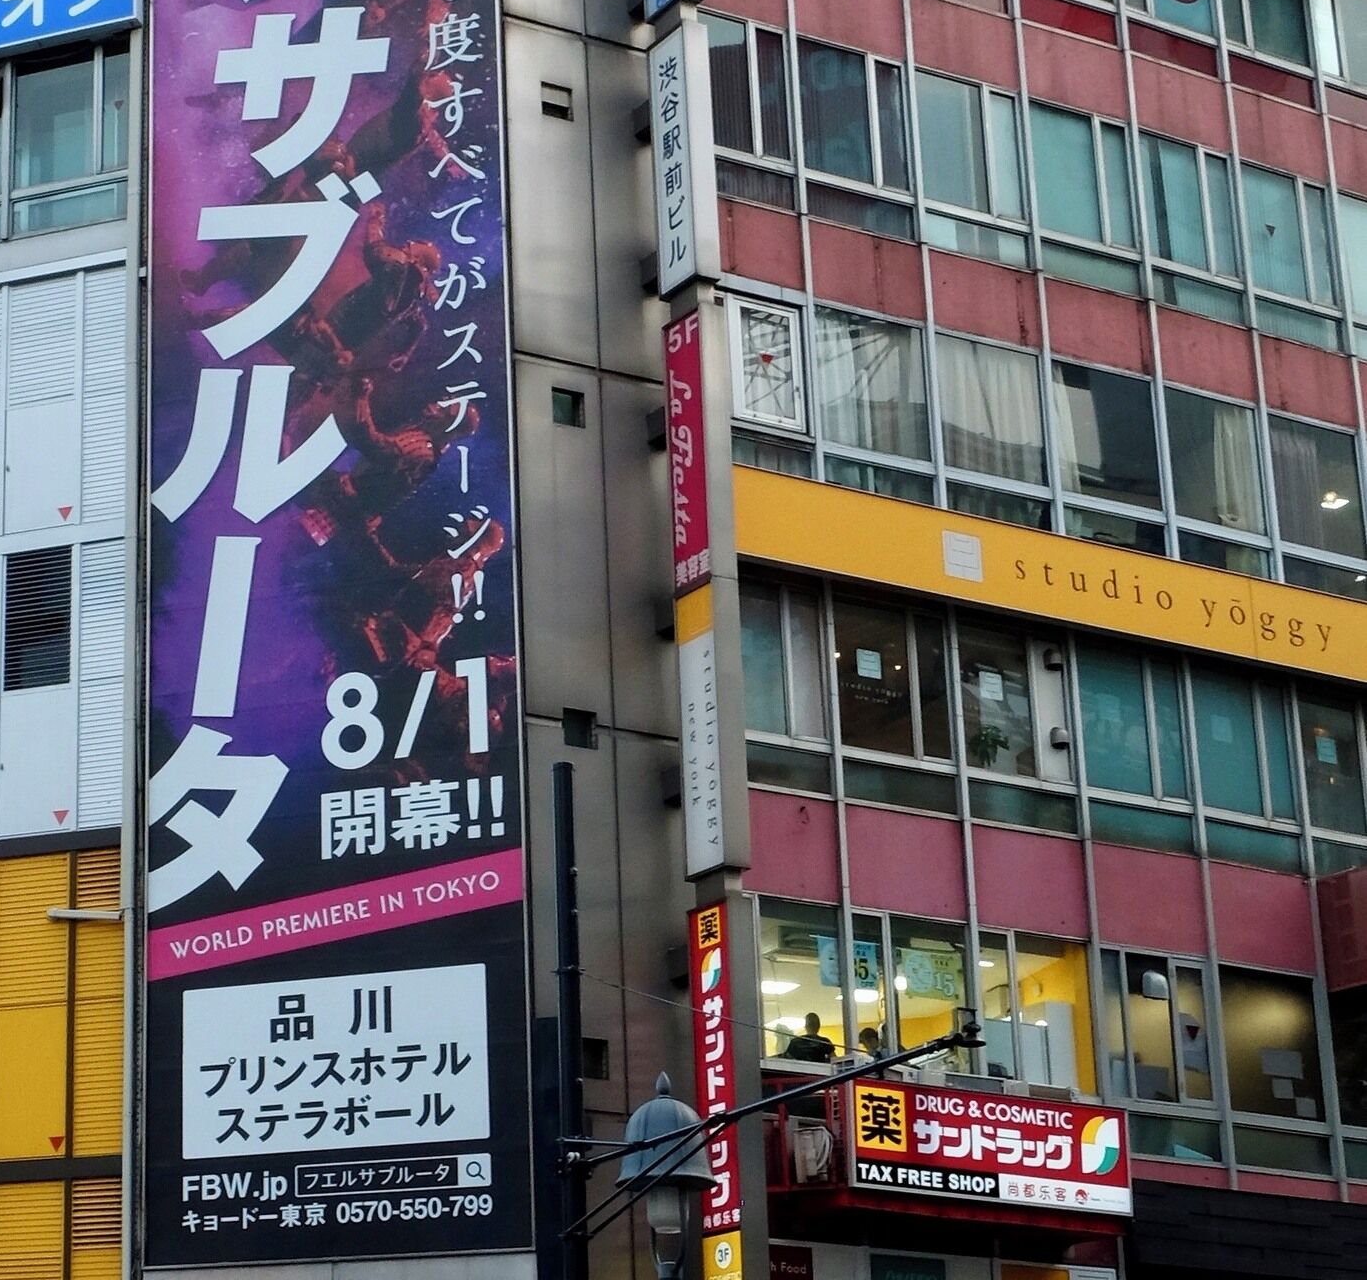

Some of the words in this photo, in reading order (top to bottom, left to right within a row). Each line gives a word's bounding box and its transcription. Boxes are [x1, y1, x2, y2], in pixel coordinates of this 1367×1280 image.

[658, 56, 687, 269] 渋谷駅前ビル
[667, 315, 700, 354] 5F
[675, 547, 711, 588] 美容室
[1014, 556, 1174, 612] studio
[320, 656, 493, 771] 8/1
[320, 774, 507, 861] 開幕!!
[170, 926, 254, 960] WORLD
[262, 899, 371, 940] PREMIERE
[380, 891, 404, 915] IN
[413, 870, 501, 907] TOKYO
[700, 912, 720, 946] 薬
[199, 1041, 473, 1099] プリンスホテル
[215, 1091, 456, 1144] ステラボール
[860, 1092, 903, 1145] 薬
[915, 1094, 965, 1116] DRUG
[967, 1099, 981, 1118] &
[982, 1101, 1073, 1130] COSMETIC
[914, 1118, 1073, 1170] サンドラッグ
[181, 1171, 288, 1203] FBW.jp
[303, 1161, 451, 1190] フエルサブルータ
[857, 1163, 893, 1183] TAX
[897, 1167, 945, 1188] FREE
[947, 1172, 996, 1194] SHOP
[181, 1202, 328, 1234] キョードー東京
[336, 1193, 494, 1225] 0570-550-799
[717, 1246, 730, 1266] 3F
[780, 1262, 807, 1274] Food
